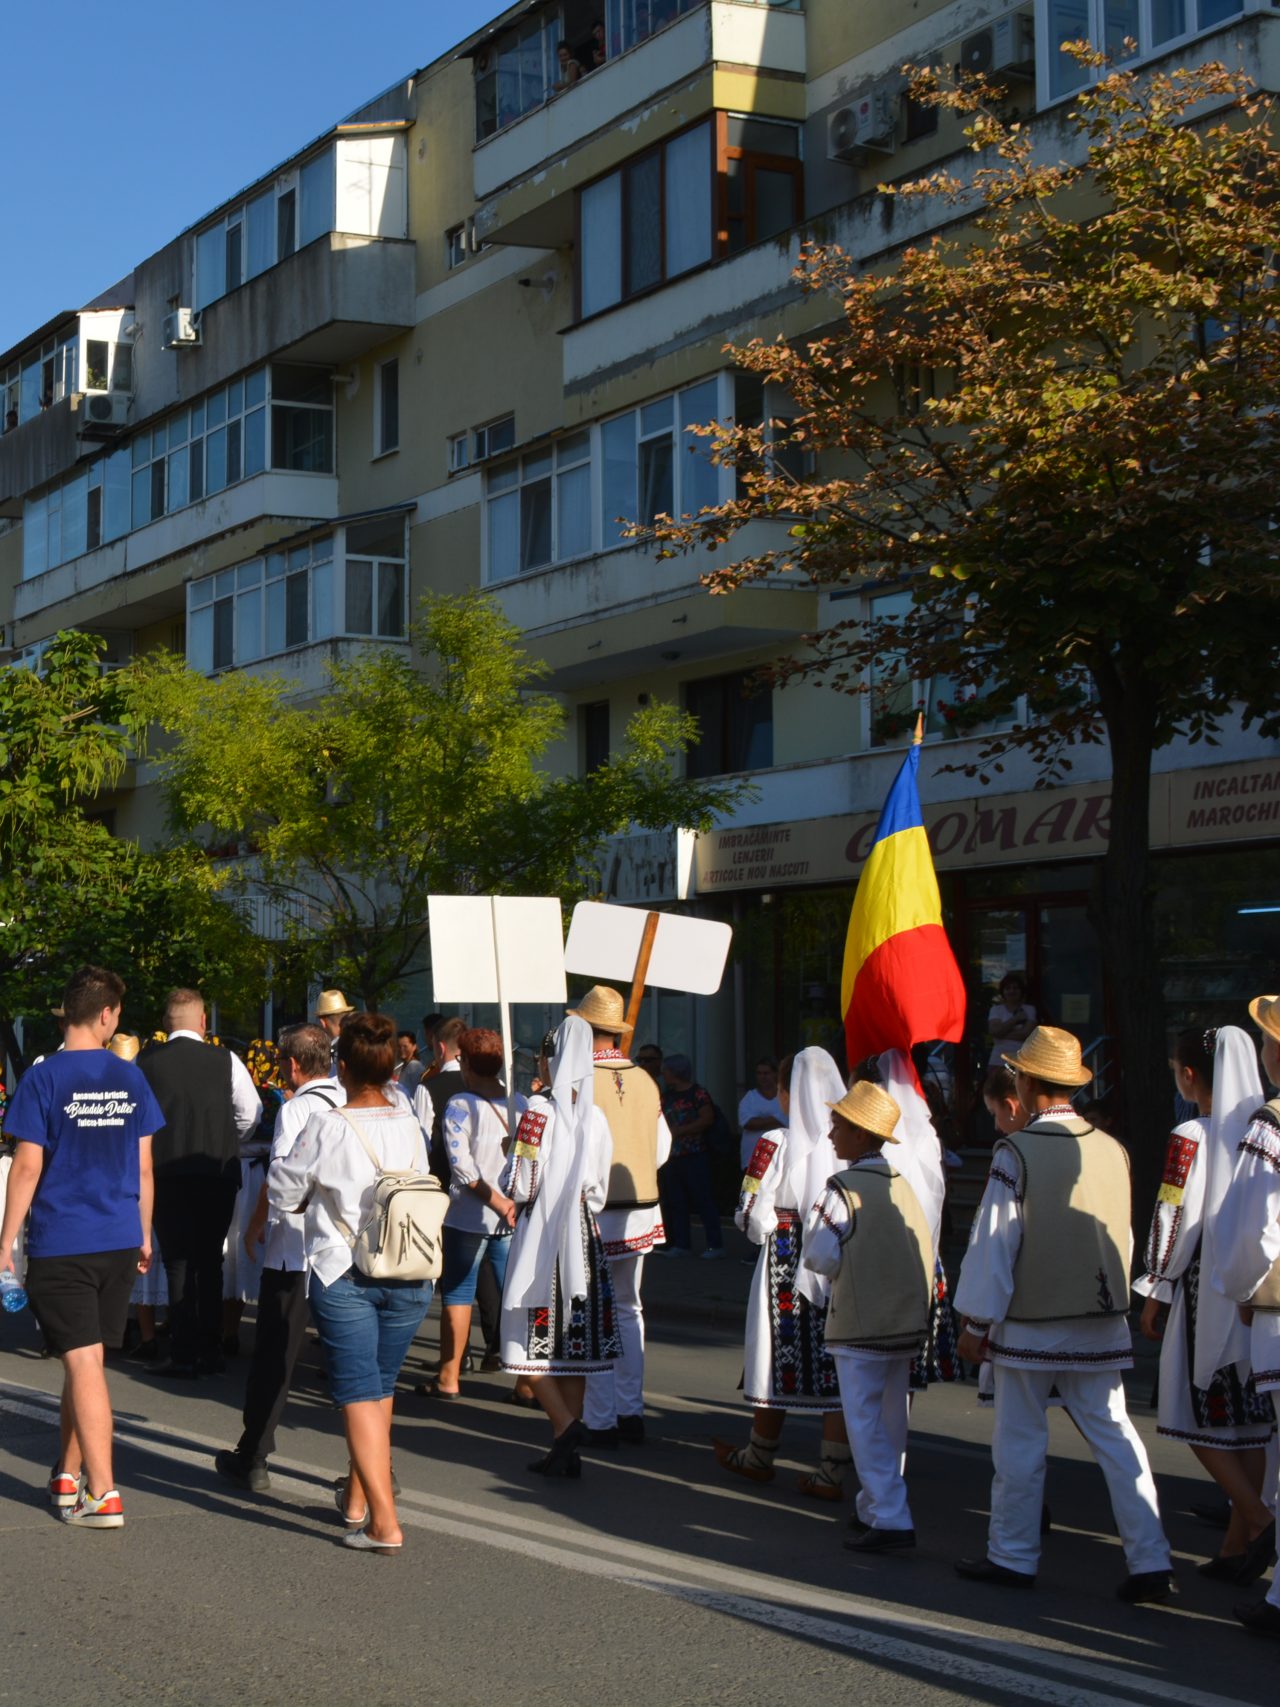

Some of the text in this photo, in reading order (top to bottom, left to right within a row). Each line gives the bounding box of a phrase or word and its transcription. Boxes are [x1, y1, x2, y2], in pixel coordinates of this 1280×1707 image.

[1186, 801, 1280, 829] MAROCHI
[733, 848, 774, 864] LENJERII
[703, 861, 808, 883] ARTICOLE NOU NASCUTI
[104, 1090, 128, 1099] Artistic
